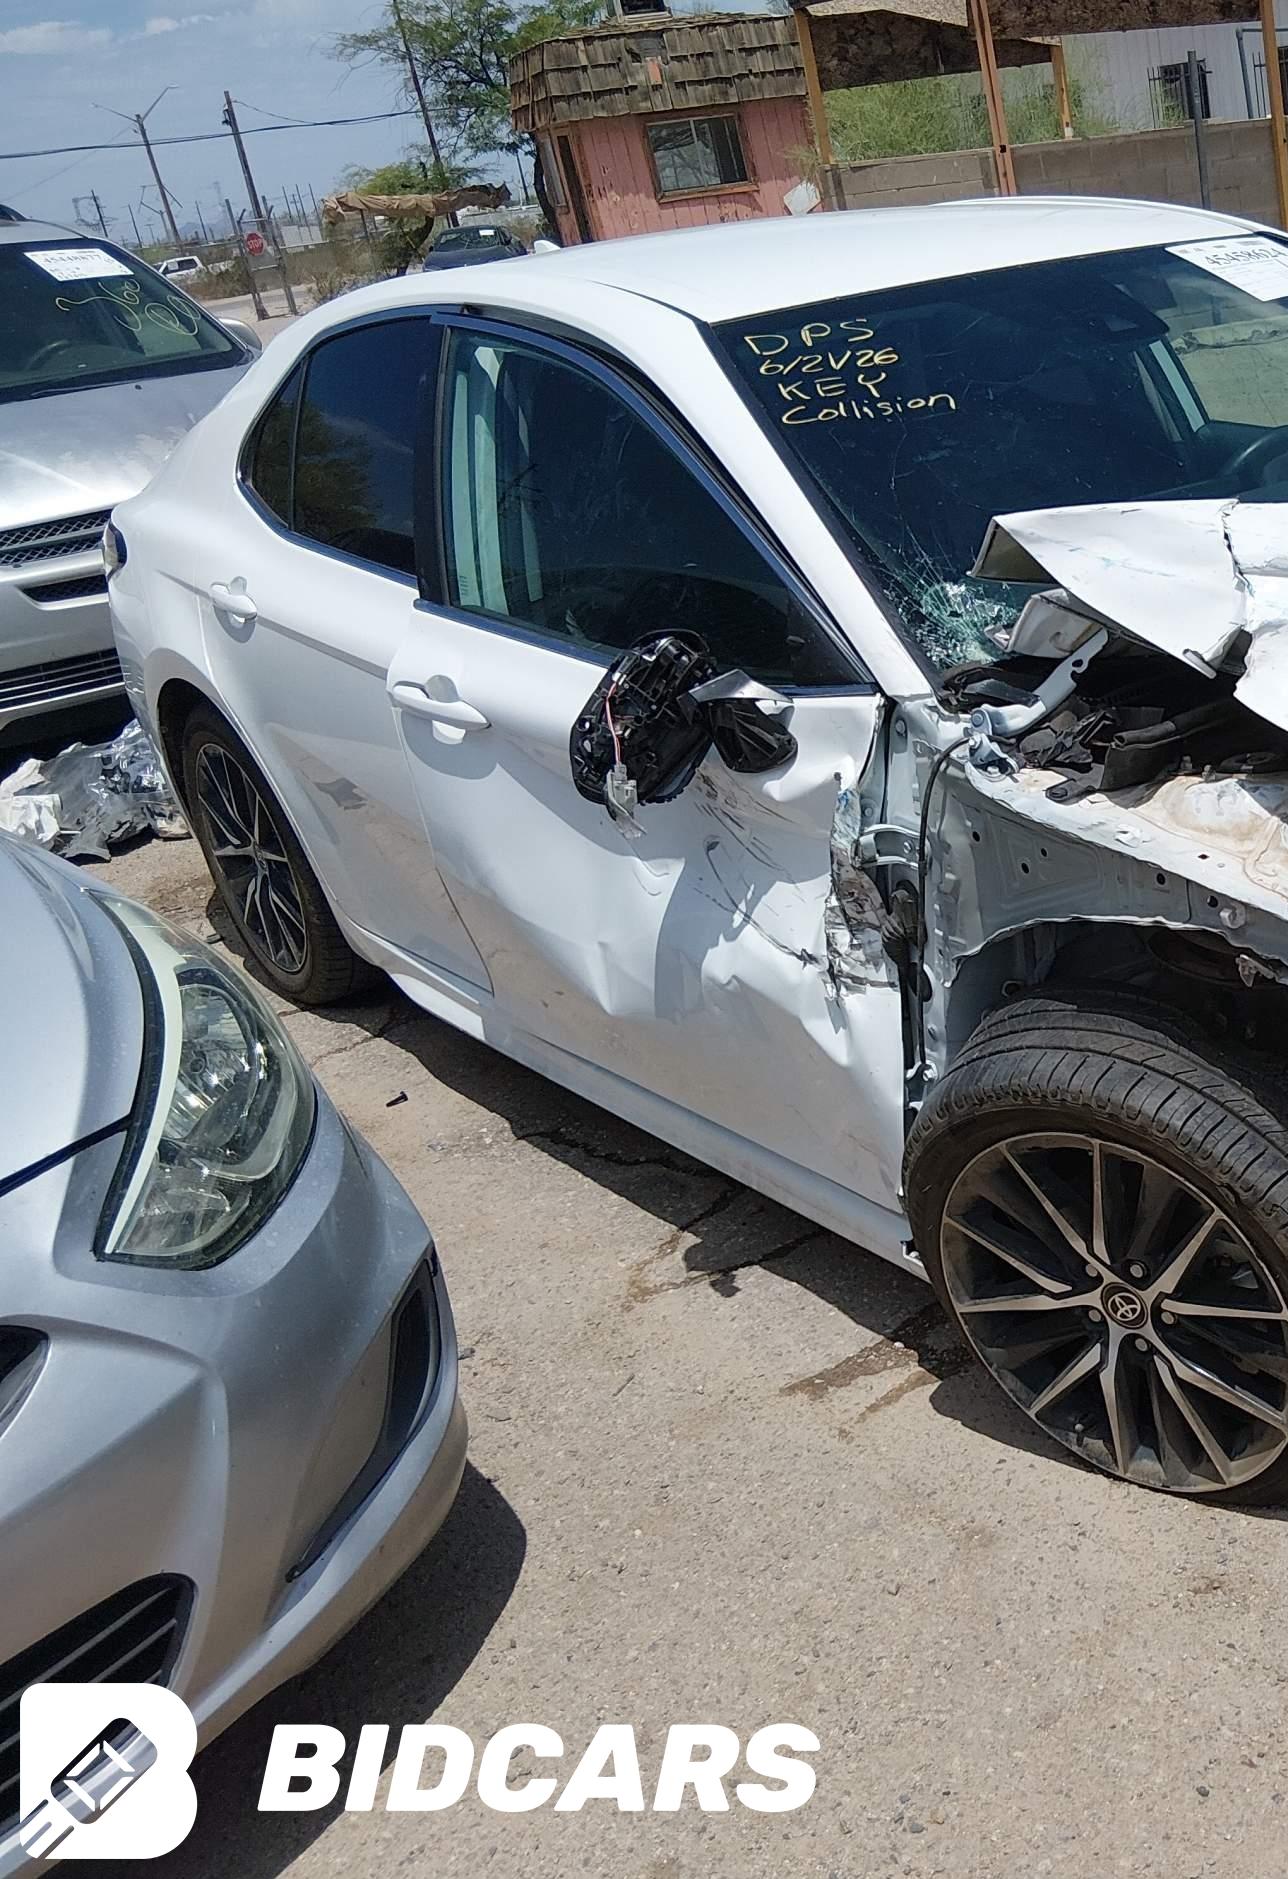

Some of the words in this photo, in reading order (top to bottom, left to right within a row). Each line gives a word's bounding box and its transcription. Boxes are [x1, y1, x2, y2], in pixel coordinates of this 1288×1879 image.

[1205, 248, 1288, 266] 45458624
[778, 371, 887, 400] KEY
[781, 393, 956, 424] Collision
